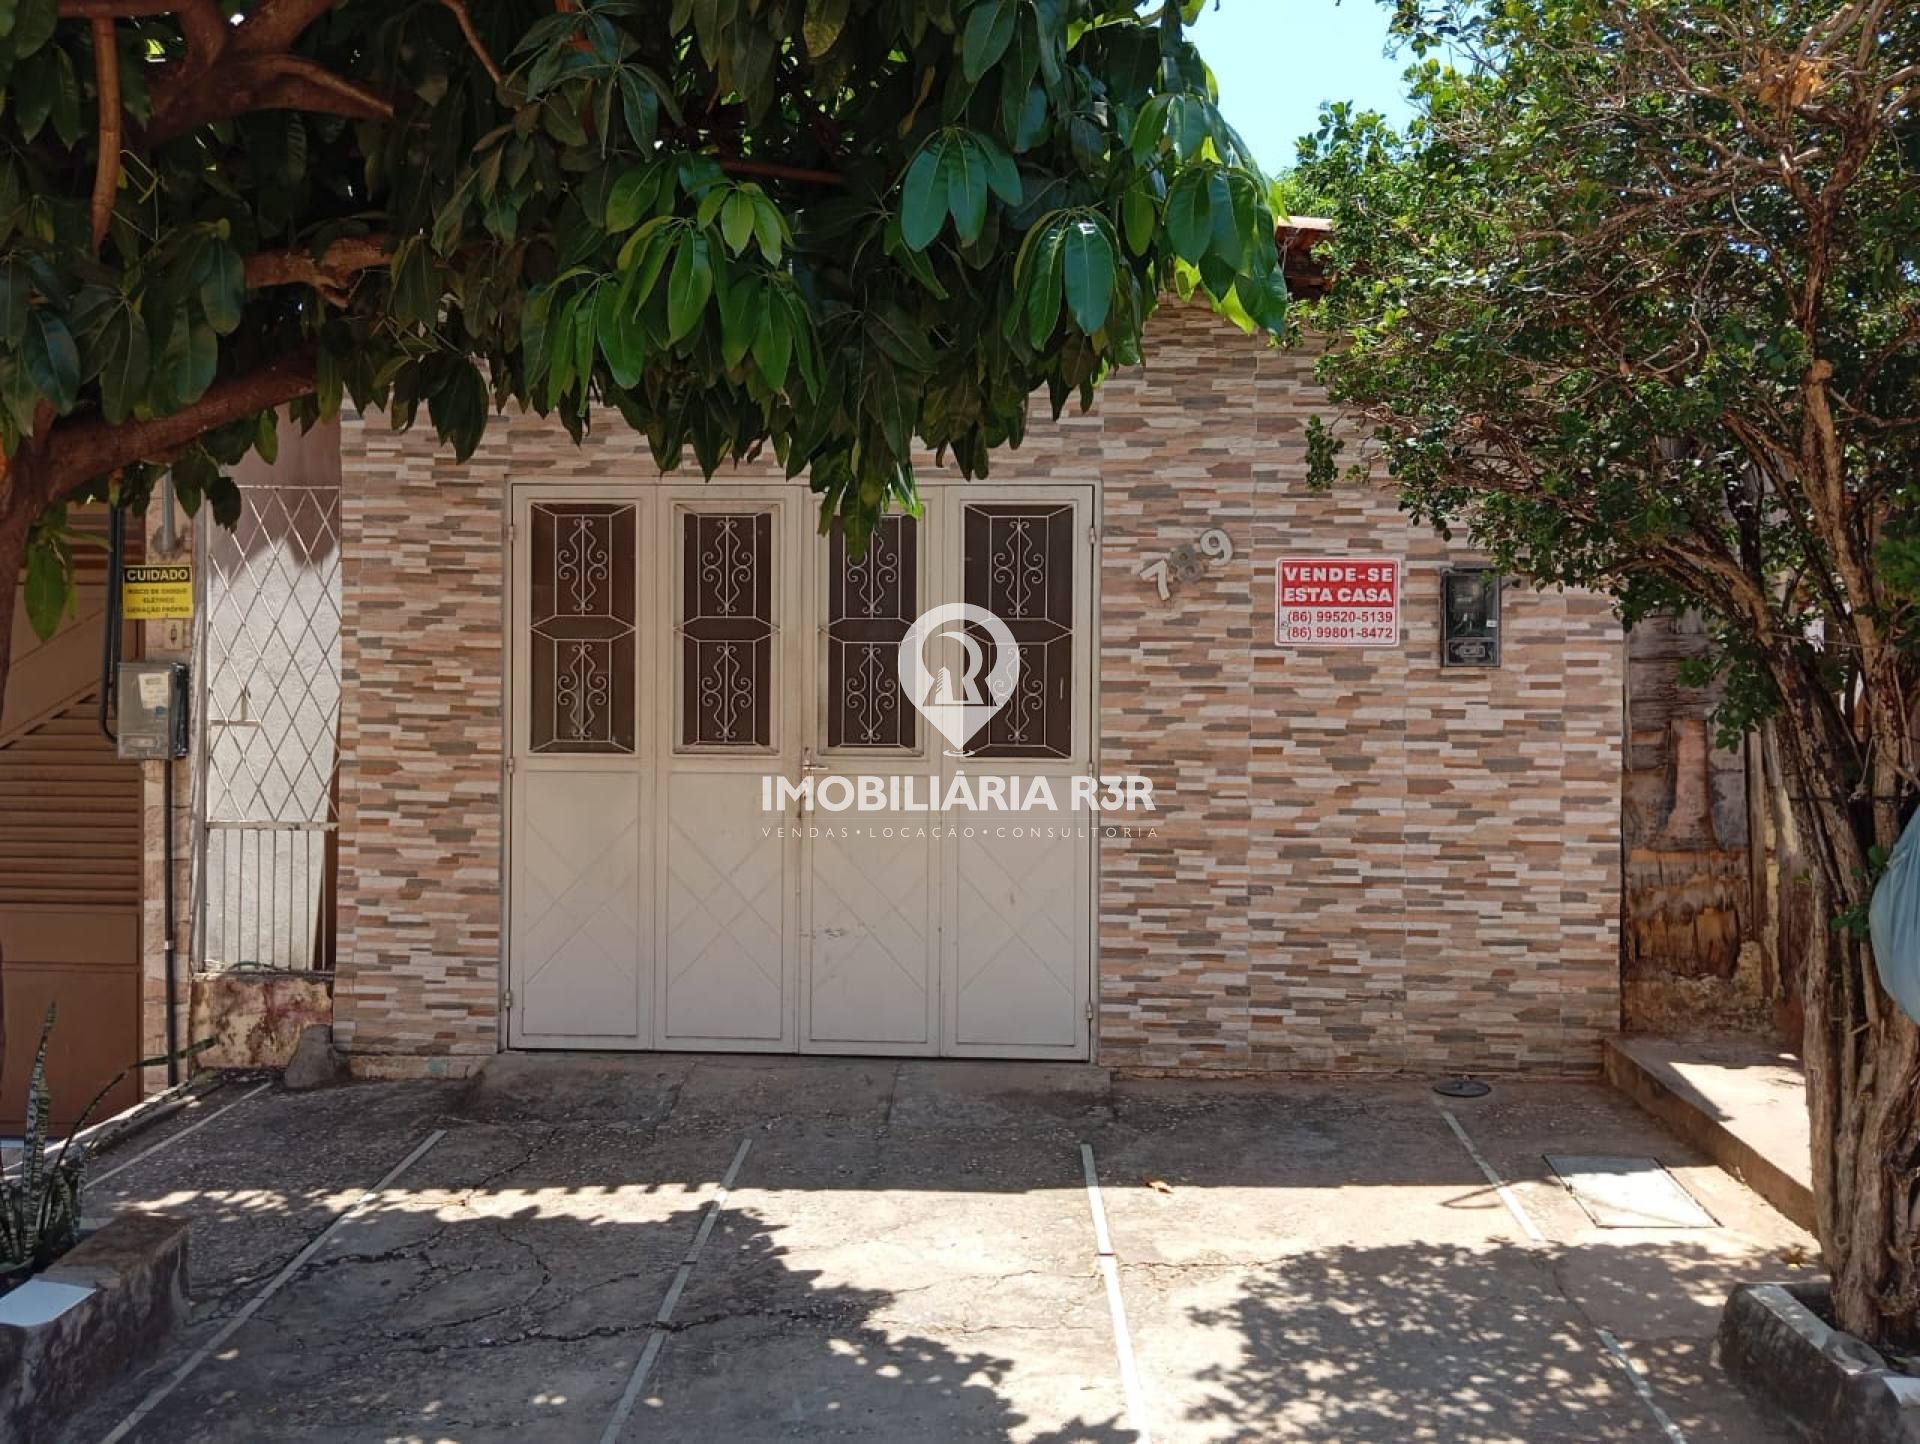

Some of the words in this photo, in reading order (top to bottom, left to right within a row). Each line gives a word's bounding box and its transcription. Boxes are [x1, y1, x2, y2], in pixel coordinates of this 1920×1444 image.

[126, 569, 188, 581] CUIDADO
[1283, 567, 1393, 583] VENDE-SE
[1283, 587, 1333, 602] ESTA
[1337, 587, 1393, 602] CASA
[1288, 611, 1312, 624] (86)
[1316, 611, 1393, 623] 99520-5139
[1288, 627, 1312, 640] (86)
[1316, 627, 1393, 639] 99801-8472
